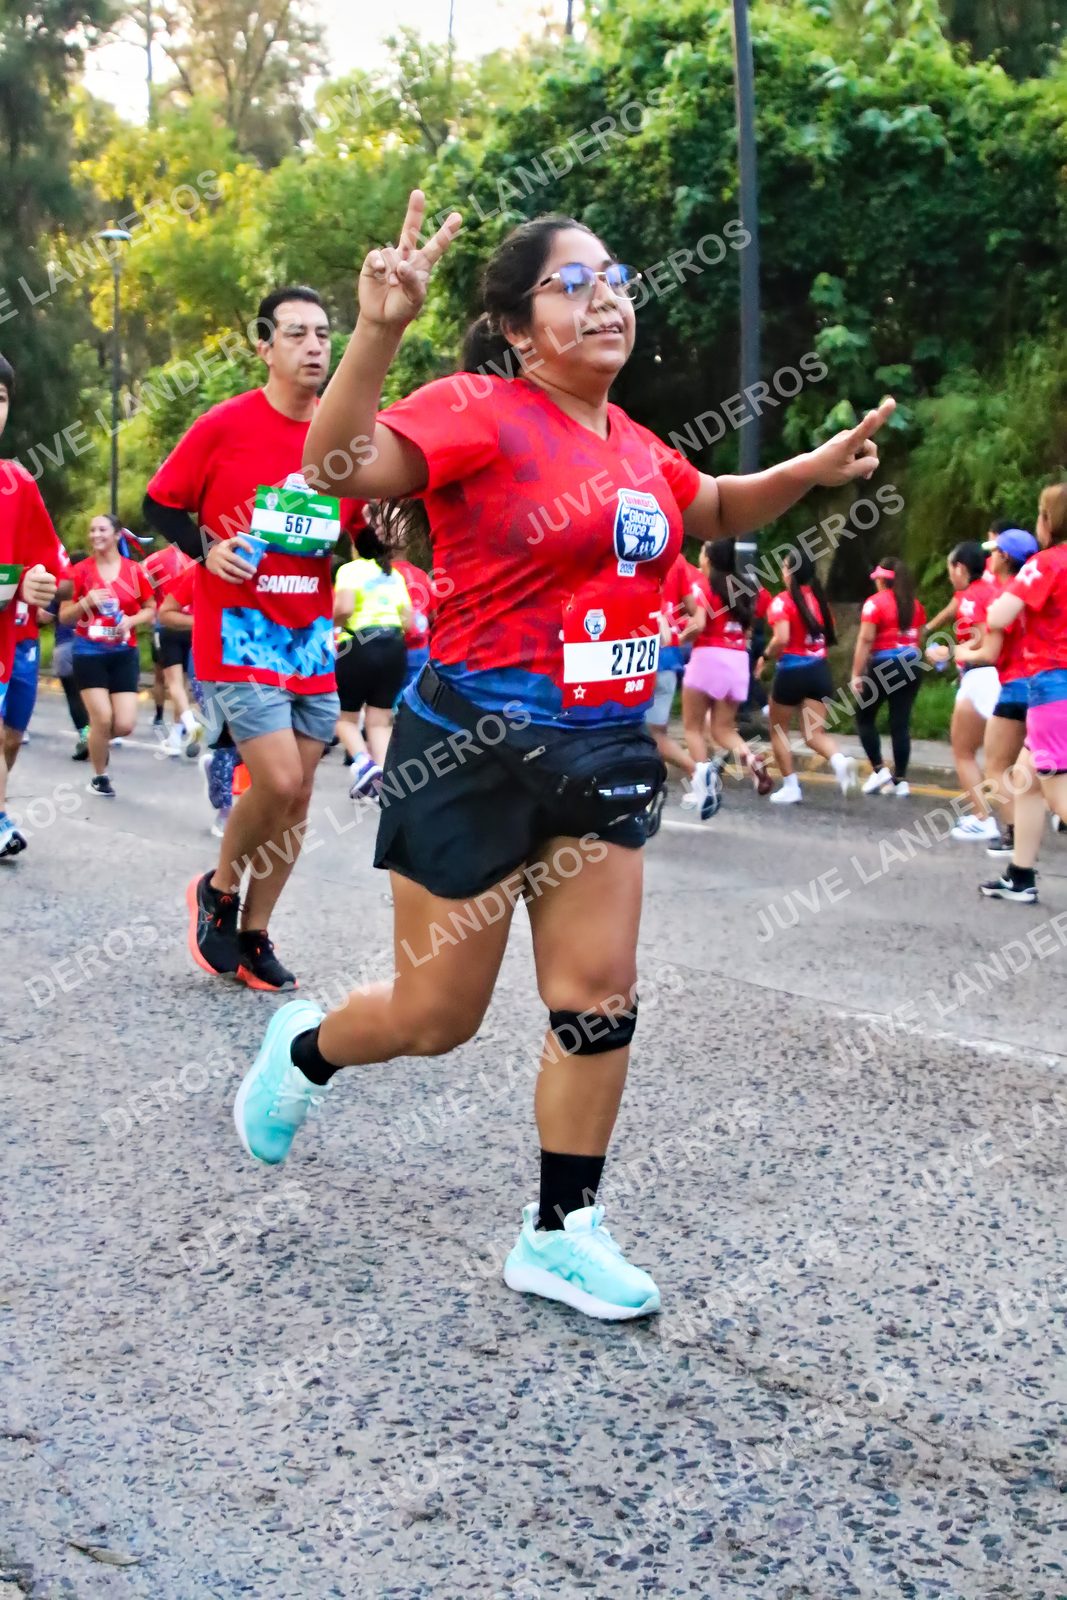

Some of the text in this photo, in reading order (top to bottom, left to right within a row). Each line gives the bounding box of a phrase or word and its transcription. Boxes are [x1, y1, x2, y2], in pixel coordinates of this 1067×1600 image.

[285, 515, 312, 535] 567
[623, 519, 646, 537] Race
[628, 508, 657, 528] Global
[611, 639, 657, 676] 2728
